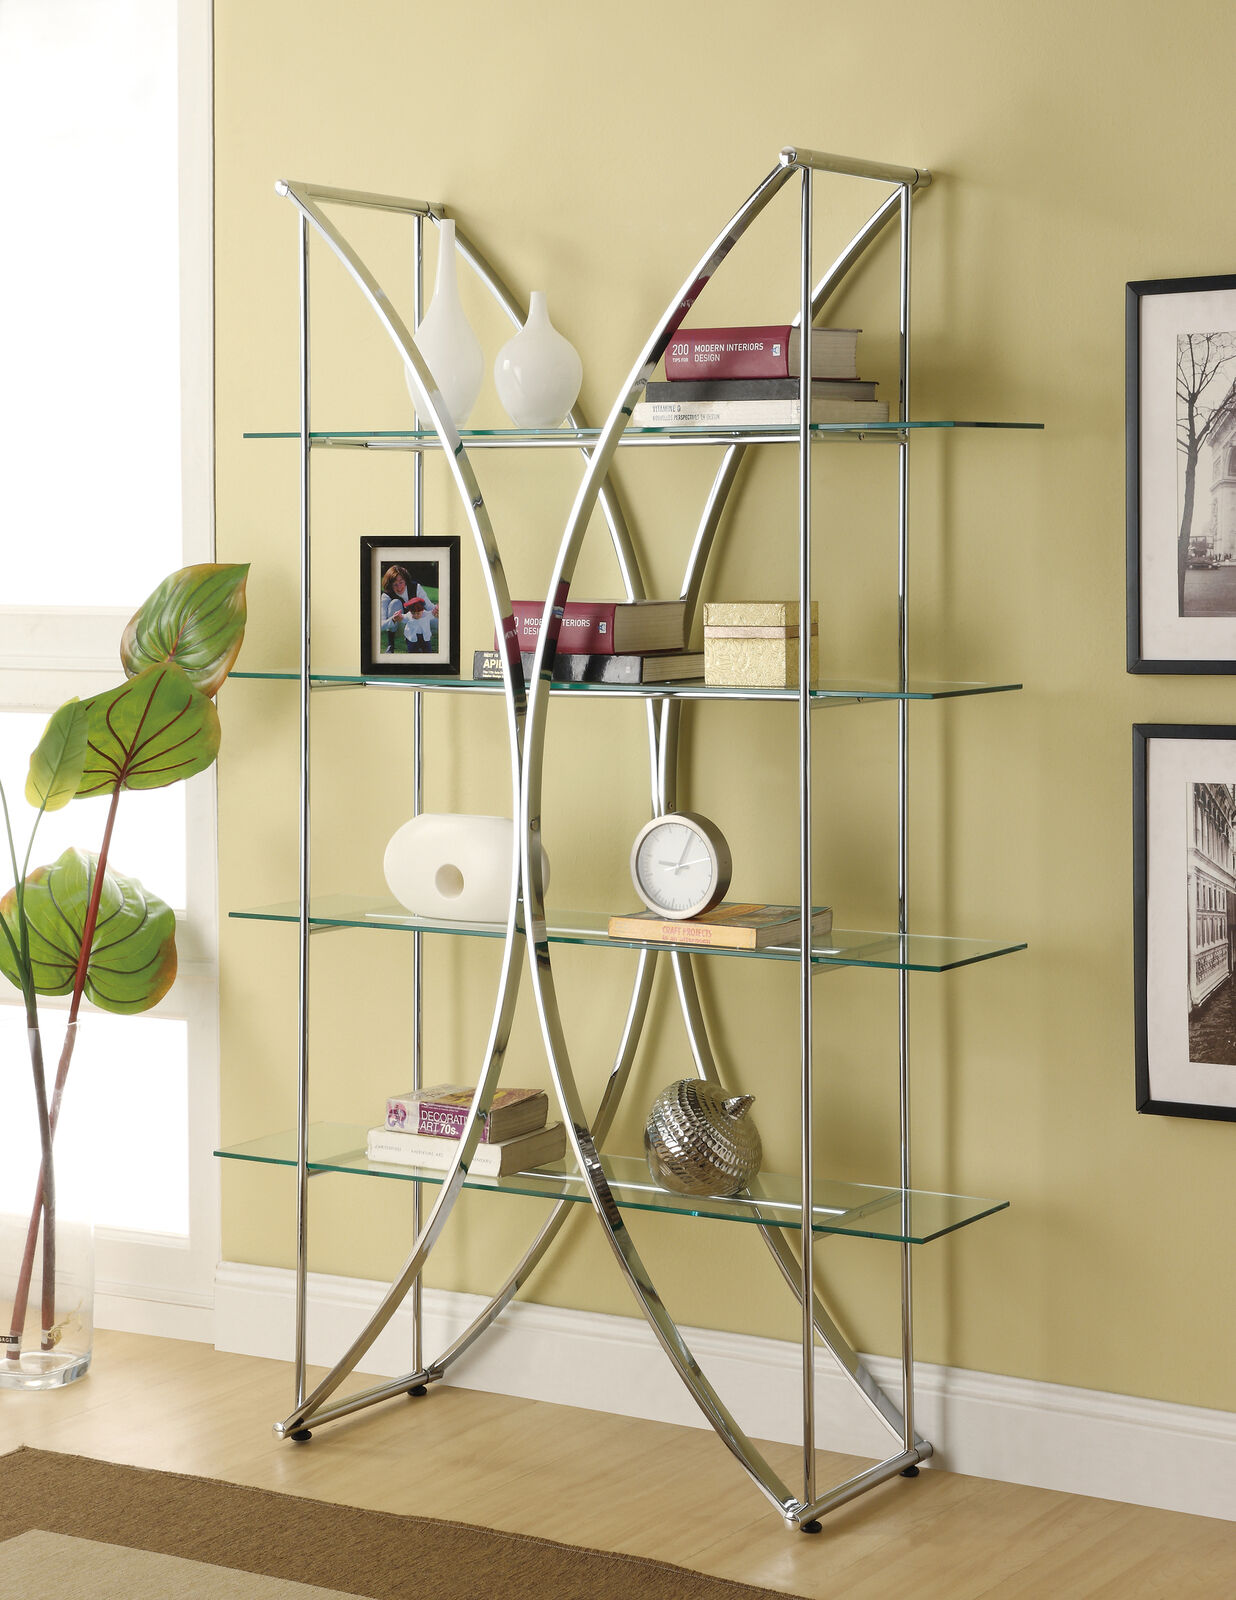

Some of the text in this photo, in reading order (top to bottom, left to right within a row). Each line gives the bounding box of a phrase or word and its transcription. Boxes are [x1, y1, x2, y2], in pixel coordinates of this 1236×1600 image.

[672, 344, 689, 355] 200
[694, 342, 764, 352] MODERN INTERIORS
[694, 353, 720, 362] DESIGN
[523, 617, 542, 626] MODE
[562, 618, 591, 627] TERIORS
[523, 626, 539, 635] DESI
[662, 926, 712, 937] CRAFT PROJECTS
[421, 1110, 468, 1126] DECORATI
[420, 1121, 457, 1135] ART 70s
